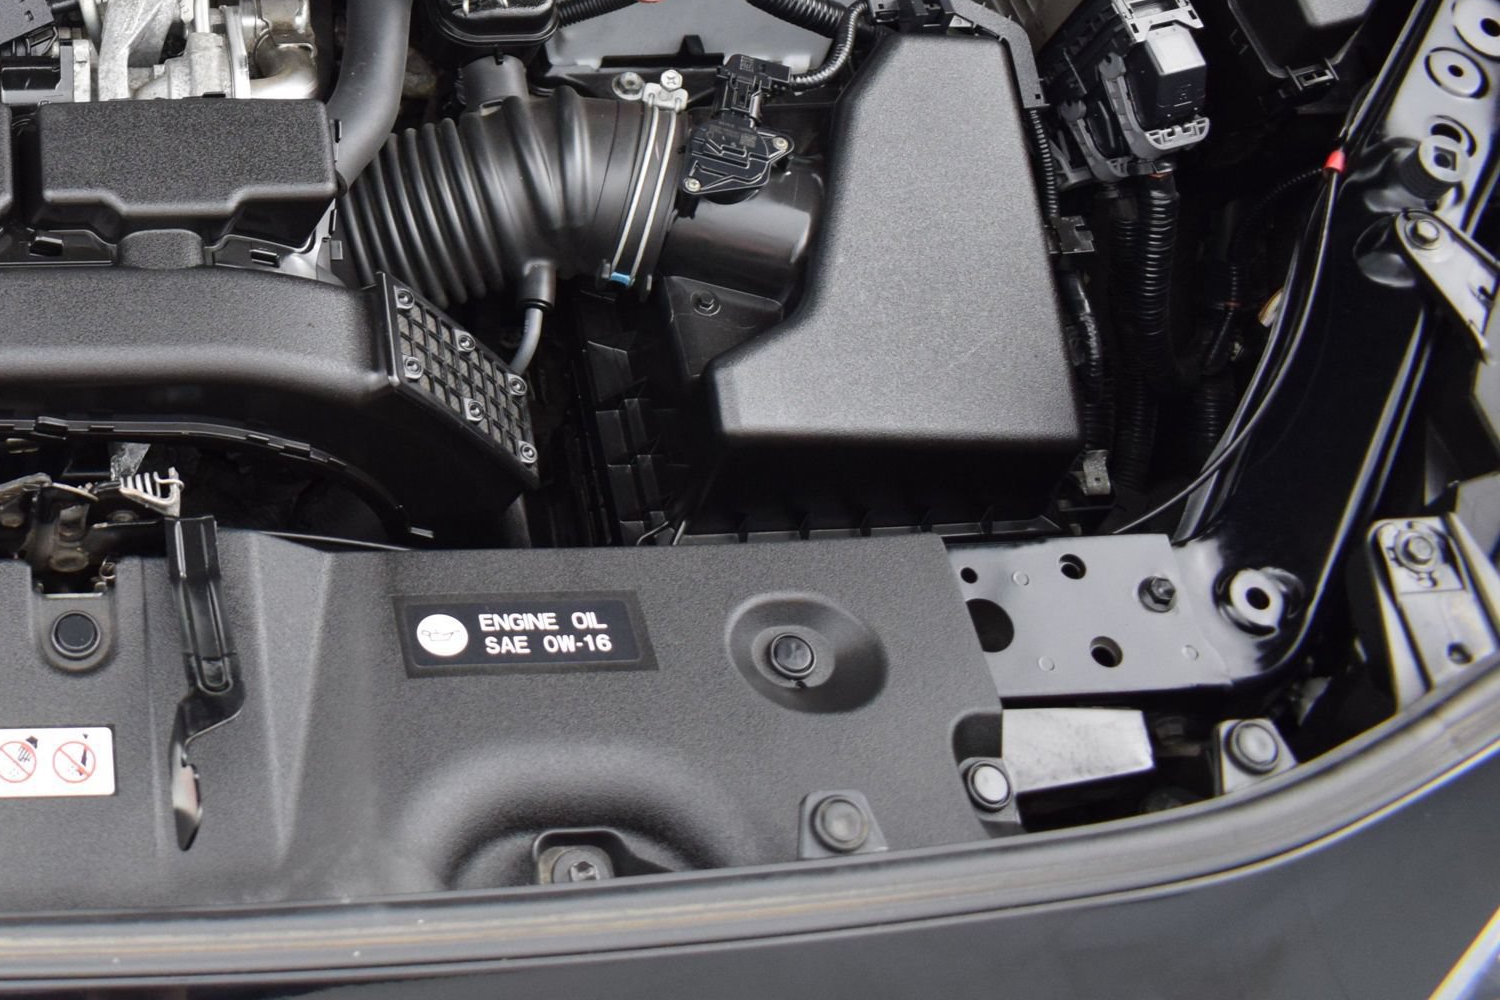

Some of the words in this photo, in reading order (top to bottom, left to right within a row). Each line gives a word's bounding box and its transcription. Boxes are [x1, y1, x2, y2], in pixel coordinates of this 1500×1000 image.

[478, 613, 559, 631] ENGINE
[571, 612, 607, 629] OIL
[485, 636, 530, 654] SAE
[544, 635, 612, 653] 0W-16
